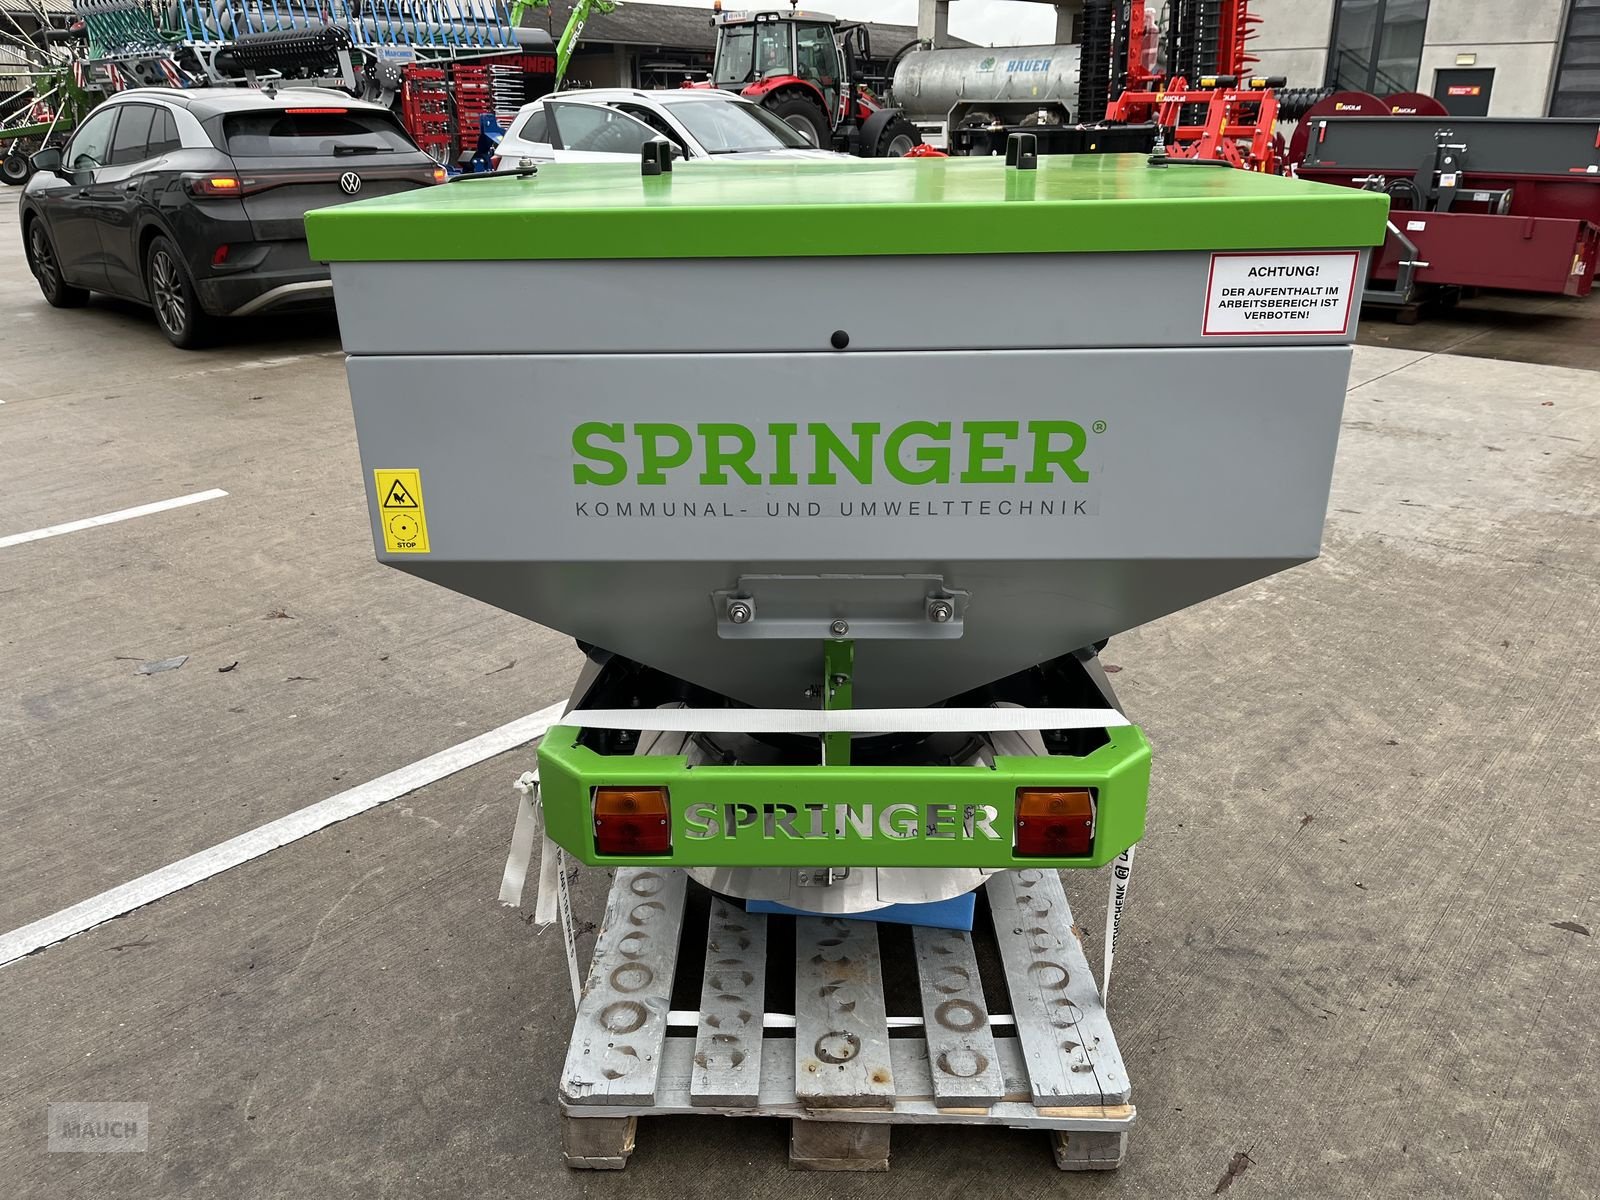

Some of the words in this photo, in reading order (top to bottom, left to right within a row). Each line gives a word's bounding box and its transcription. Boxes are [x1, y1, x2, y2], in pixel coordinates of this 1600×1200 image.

[566, 20, 584, 55] MERLO
[1007, 59, 1052, 72] BAUER
[1248, 266, 1320, 277] ACHTUNG!
[1222, 288, 1245, 297] DER
[1247, 287, 1323, 296] AUFENTHALT
[1325, 286, 1339, 295] IM
[1218, 299, 1318, 308] ARBEITSBEREICH
[1320, 298, 1339, 307] IST
[1244, 311, 1310, 320] VERBOTEN!
[571, 420, 1090, 486] SPRINGER
[576, 502, 747, 516] KOMMUNAL-
[767, 502, 821, 516] UND
[840, 500, 1088, 516] UMWELTTECHNIK
[684, 802, 1003, 840] SPRINGER
